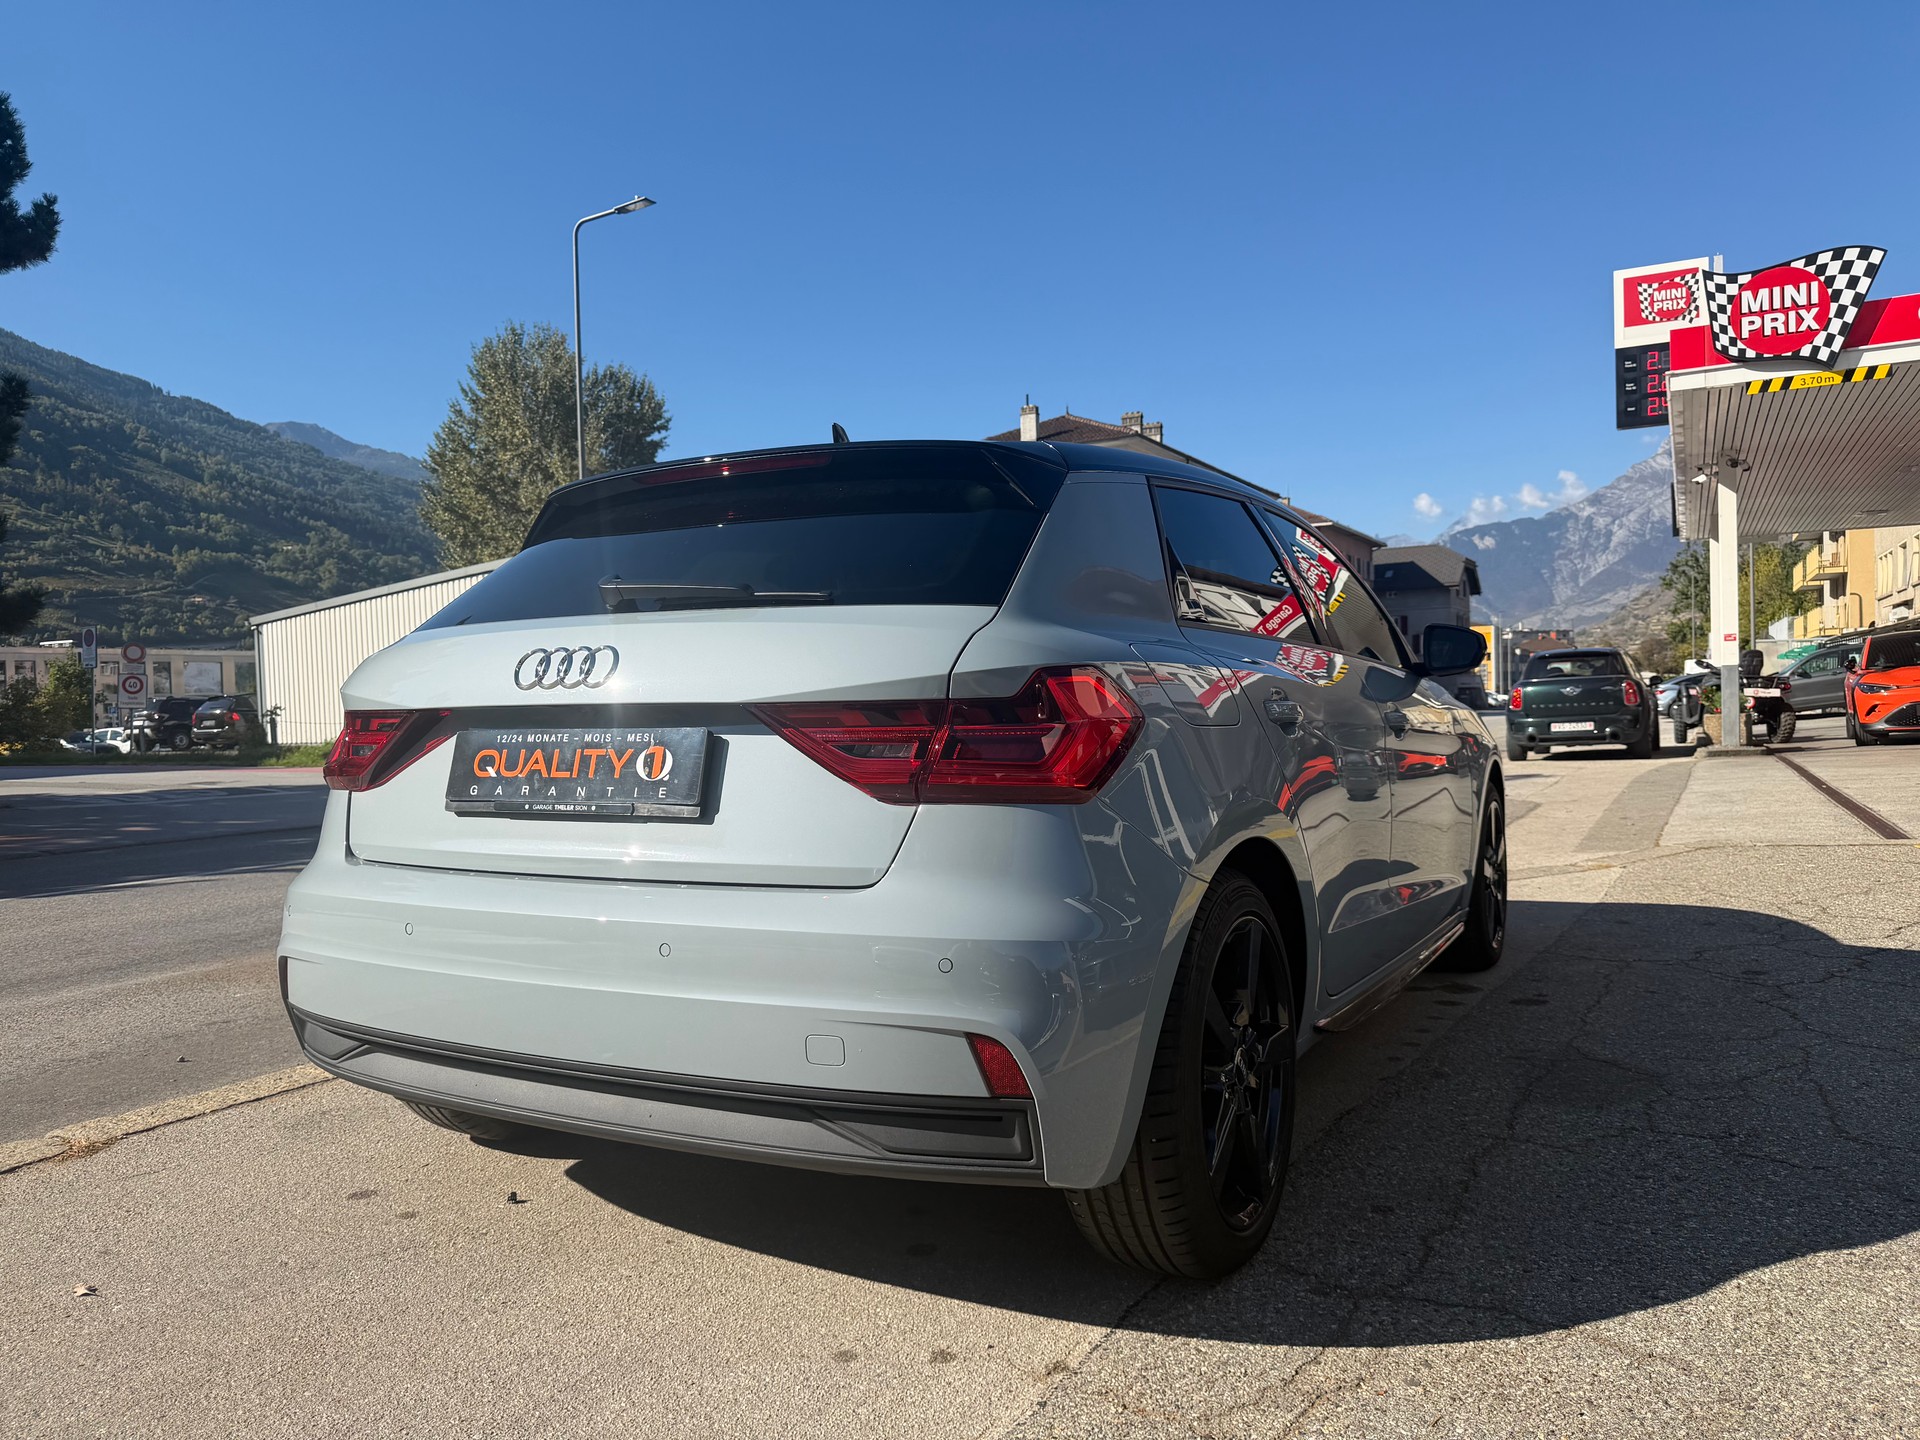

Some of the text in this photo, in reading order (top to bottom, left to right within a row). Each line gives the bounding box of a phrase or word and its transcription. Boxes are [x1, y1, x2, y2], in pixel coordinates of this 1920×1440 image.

[1653, 287, 1687, 302] MINI
[1740, 280, 1820, 315] MINI
[1653, 299, 1687, 312] PRIX
[1741, 307, 1821, 340] PRIX
[128, 681, 138, 689] 40
[496, 734, 523, 743] 12/24
[527, 734, 569, 743] MONATE
[584, 733, 612, 743] MOIS
[473, 748, 634, 778] QUALITY
[470, 786, 666, 798] GARANTIE
